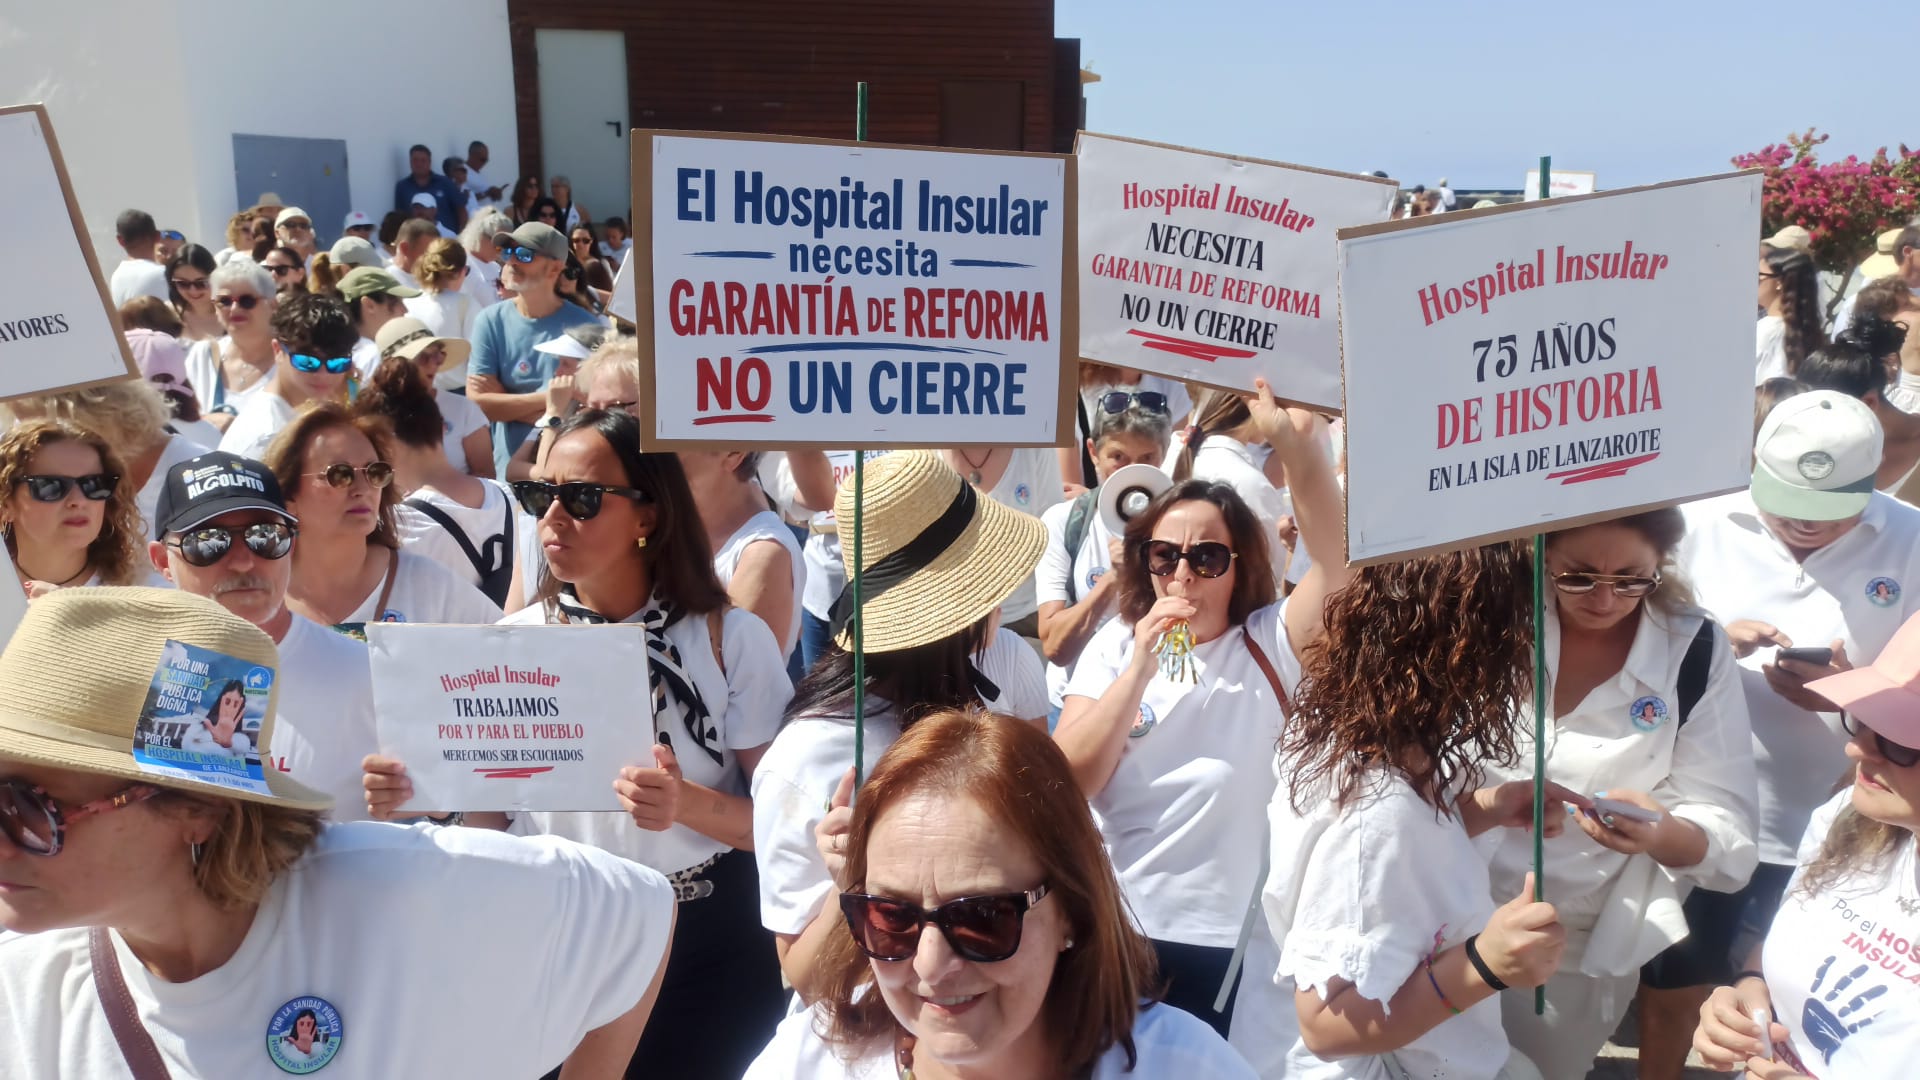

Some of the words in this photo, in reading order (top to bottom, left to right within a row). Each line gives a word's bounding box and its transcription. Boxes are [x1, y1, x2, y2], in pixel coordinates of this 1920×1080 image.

[677, 168, 715, 222] El
[734, 170, 903, 239] Hospital
[918, 179, 1048, 236] Insular
[1123, 182, 1221, 215] Hospital
[1224, 185, 1315, 233] Insular
[789, 239, 938, 278] necesita
[1145, 222, 1264, 271] NECESITA
[1092, 253, 1183, 291] GARANTIA
[1188, 271, 1217, 297] DE
[1221, 276, 1320, 319] REFORMA
[1417, 249, 1545, 327] Hospital
[1555, 240, 1669, 284] Insular
[669, 276, 859, 338] GARANTÍA
[867, 297, 896, 332] DE
[903, 287, 1049, 342] REFORMA
[1120, 293, 1150, 323] NO
[1157, 300, 1189, 331] UN
[1195, 308, 1278, 351] CIERRE
[1472, 334, 1518, 383] 75
[1530, 317, 1617, 373] AÑOS
[696, 356, 772, 412] NO
[788, 361, 852, 414] UN
[869, 361, 1027, 416] CIERRE
[1437, 396, 1483, 450] DE
[1495, 365, 1662, 438] HISTORIA
[1428, 465, 1451, 492] EN
[1456, 461, 1478, 487] LA
[1483, 449, 1520, 481] ISLA
[1526, 446, 1550, 472] DE
[1555, 428, 1661, 467] LANZAROTE
[170, 656, 190, 671] POR
[191, 659, 210, 677] UNA
[440, 665, 501, 693] Hospital
[504, 665, 560, 688] Insular
[156, 695, 187, 713] DIGNA
[453, 697, 559, 717] TRABAJAMOS
[145, 731, 162, 745] POR
[162, 736, 172, 747] EL
[438, 724, 463, 739] POR
[466, 724, 473, 739] Y
[477, 724, 510, 739] PARA
[513, 723, 529, 739] EL
[532, 723, 584, 739] PUEBLO
[146, 748, 197, 763] HOSPITAL
[443, 749, 499, 761] MERECEMOS
[500, 749, 518, 761] SER
[521, 749, 584, 761] ESCUCHADOS
[1832, 898, 1860, 923] Por
[1860, 921, 1877, 935] el
[293, 999, 322, 1010] SANIDAD
